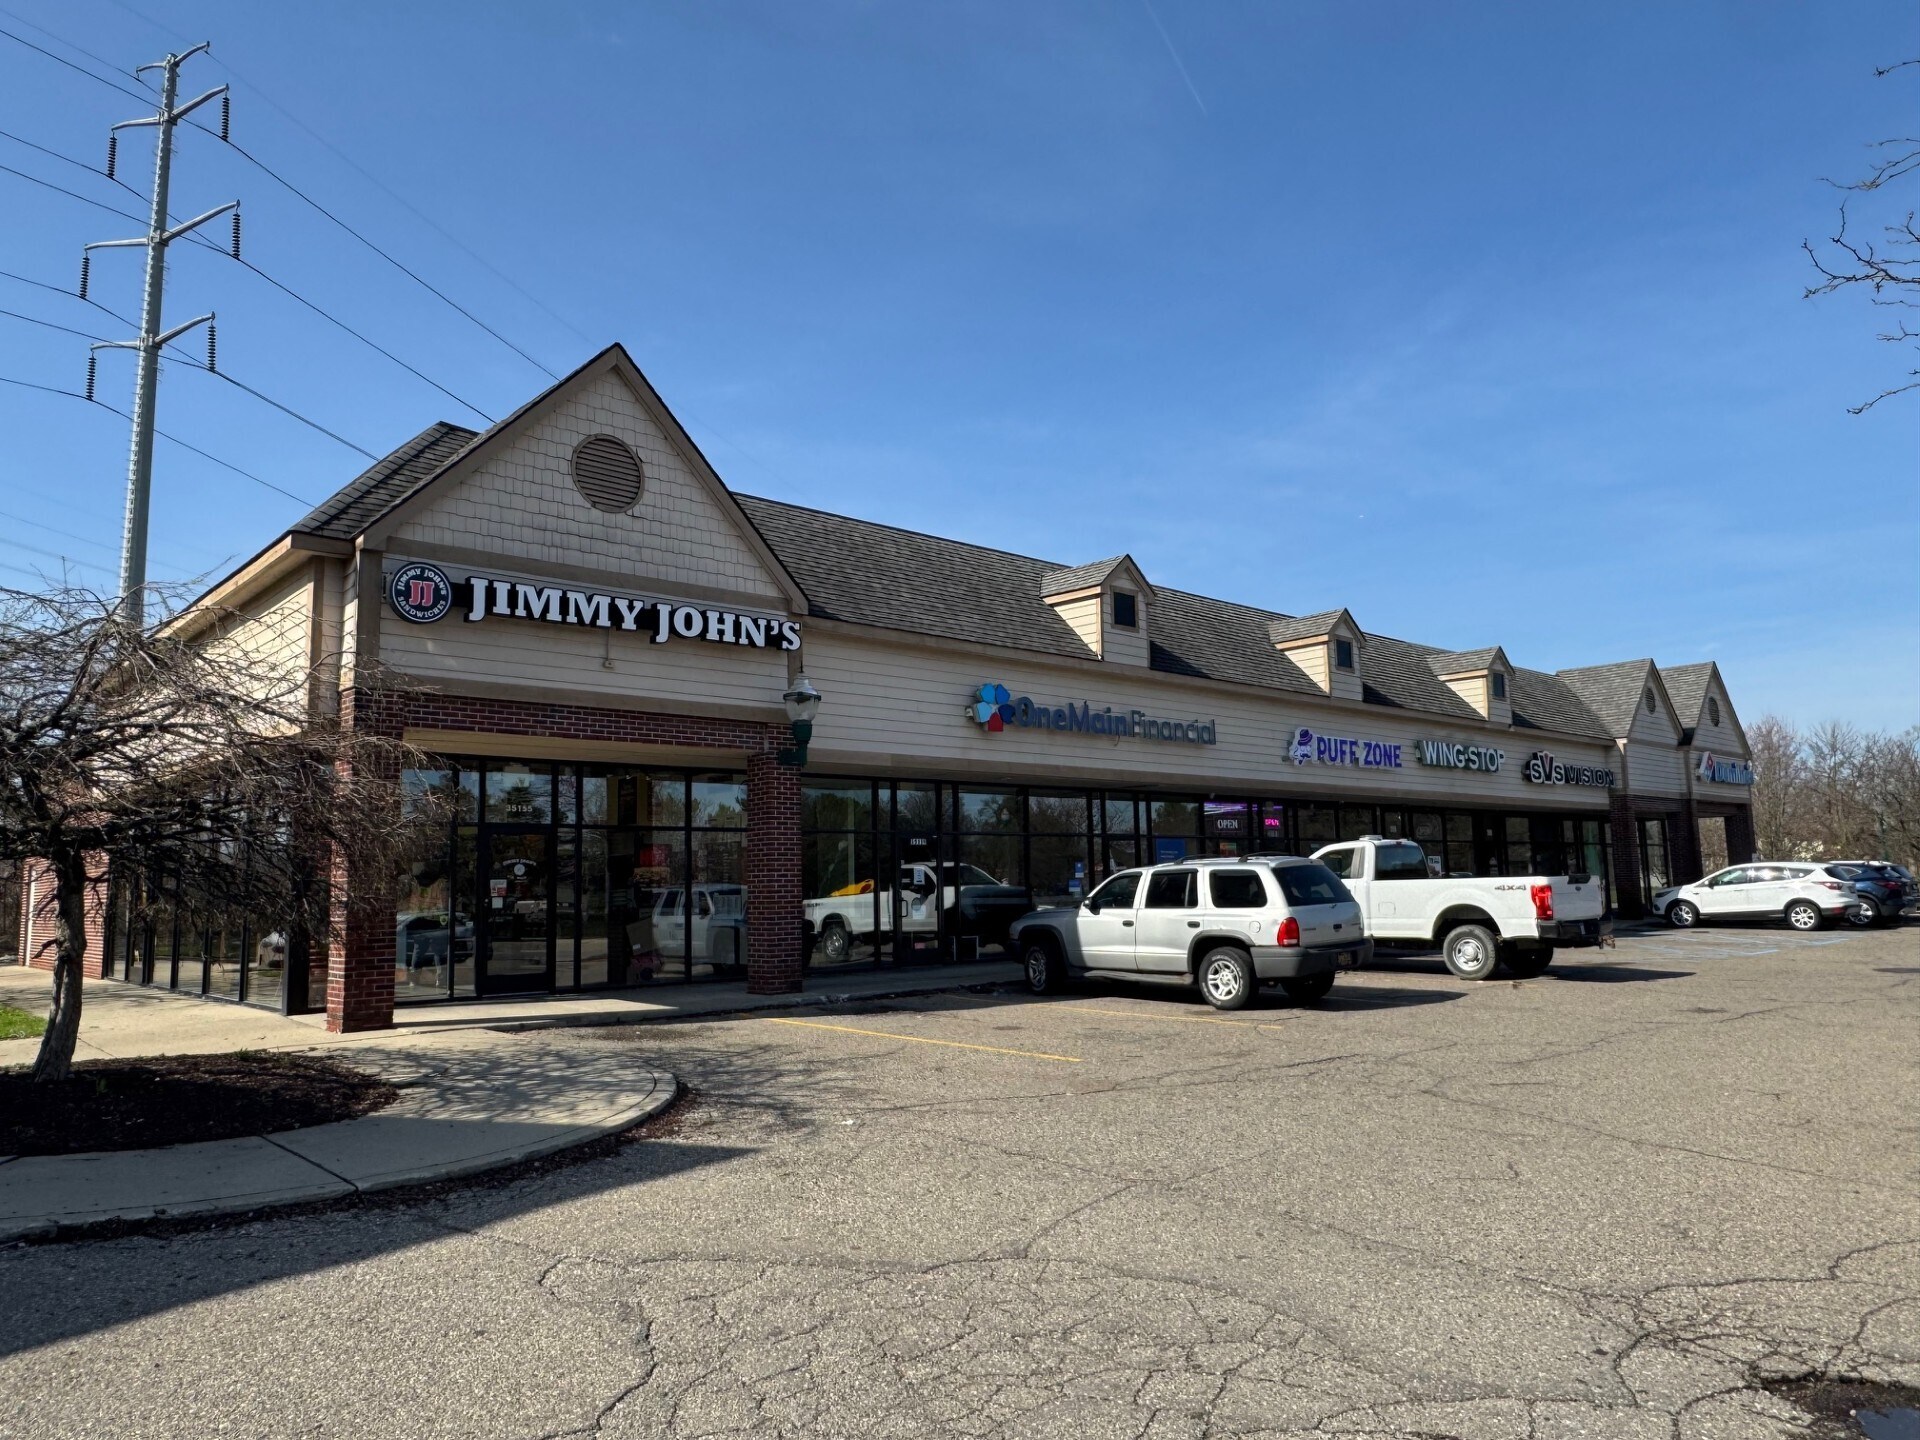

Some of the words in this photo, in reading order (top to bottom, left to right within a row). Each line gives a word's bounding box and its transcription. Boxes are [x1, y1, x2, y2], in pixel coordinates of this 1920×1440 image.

[397, 568, 421, 590] JIMMY
[424, 570, 447, 595] JOHN'S
[409, 579, 435, 607] JJ
[397, 596, 446, 618] SANDWICHES
[468, 577, 643, 631] JIMMY
[655, 603, 801, 651] JOHN'S
[1316, 736, 1359, 764] PUFF
[1363, 741, 1402, 768] ZONE
[1565, 764, 1616, 787] VISION
[505, 804, 533, 812] 35155
[1217, 819, 1239, 829] OPEN
